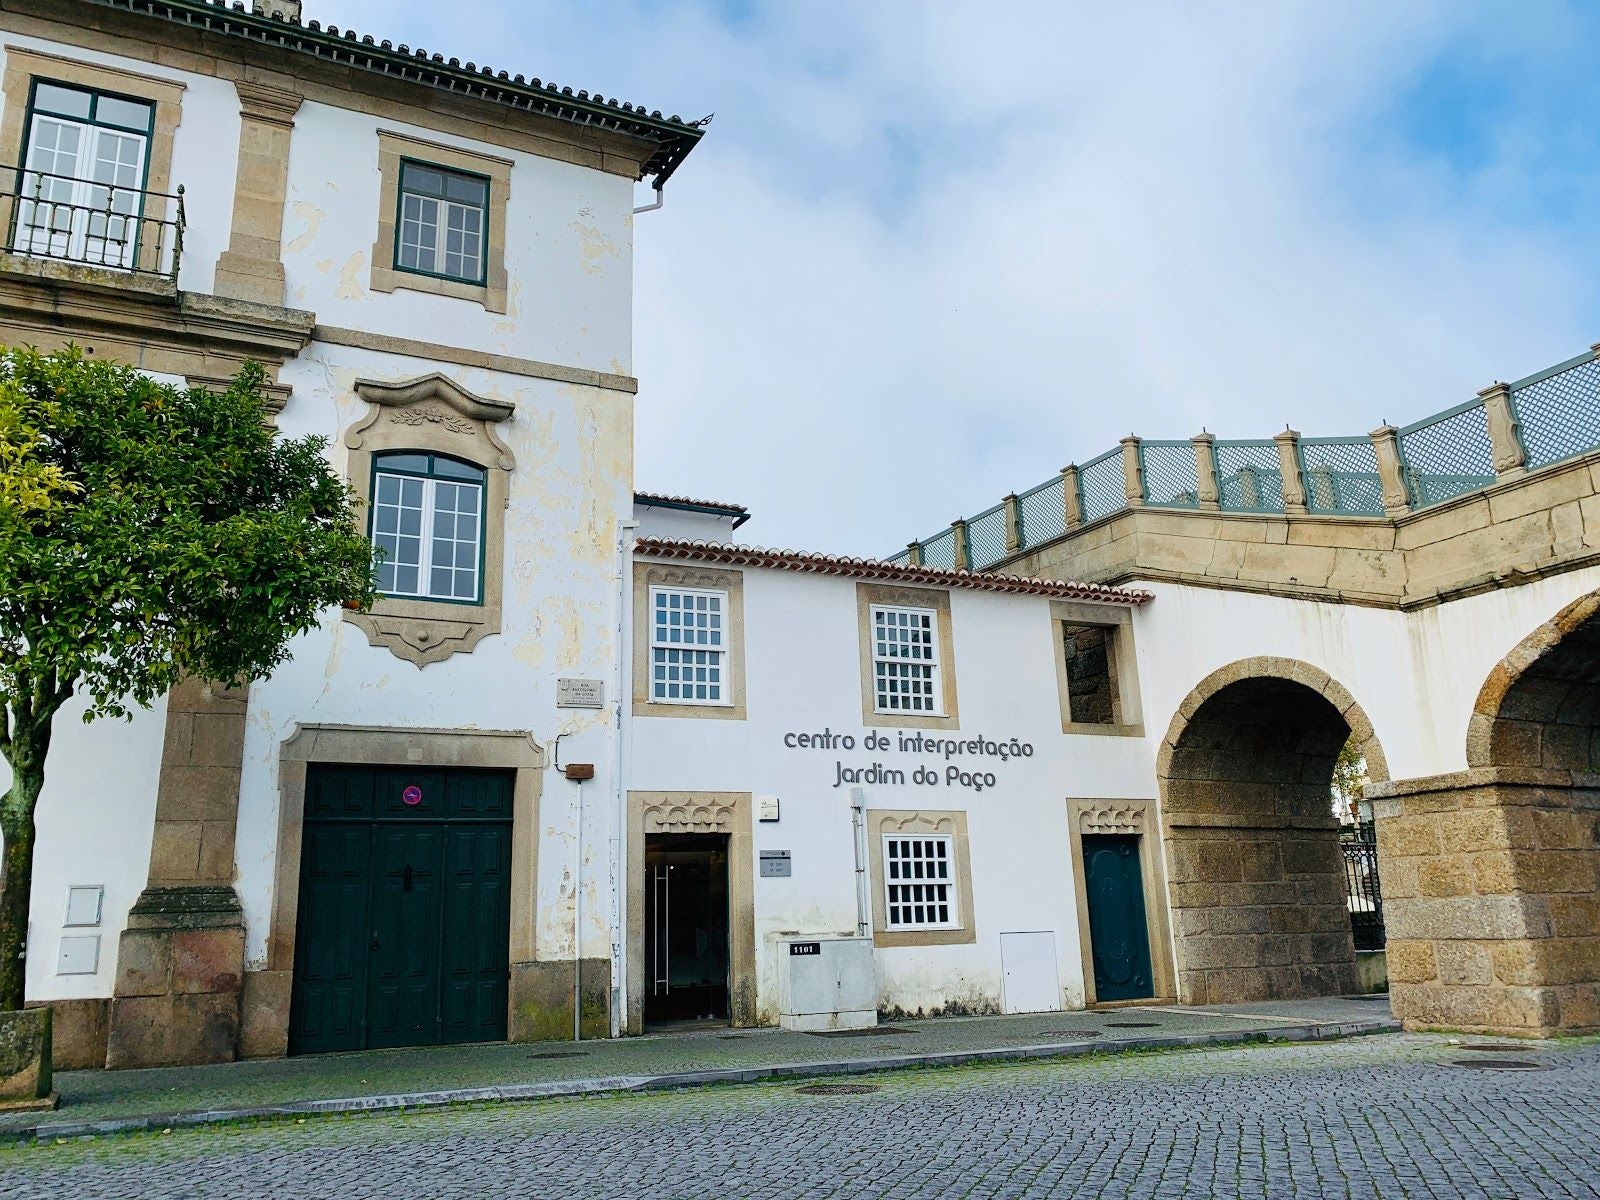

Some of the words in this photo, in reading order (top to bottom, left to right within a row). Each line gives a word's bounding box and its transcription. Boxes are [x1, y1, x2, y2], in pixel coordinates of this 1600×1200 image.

[783, 727, 856, 750] centro
[863, 729, 891, 752] de
[898, 730, 1034, 762] interpretação
[832, 761, 905, 788] Jardim
[912, 764, 939, 786] do
[945, 765, 997, 792] Paço
[793, 945, 813, 954] 1101
